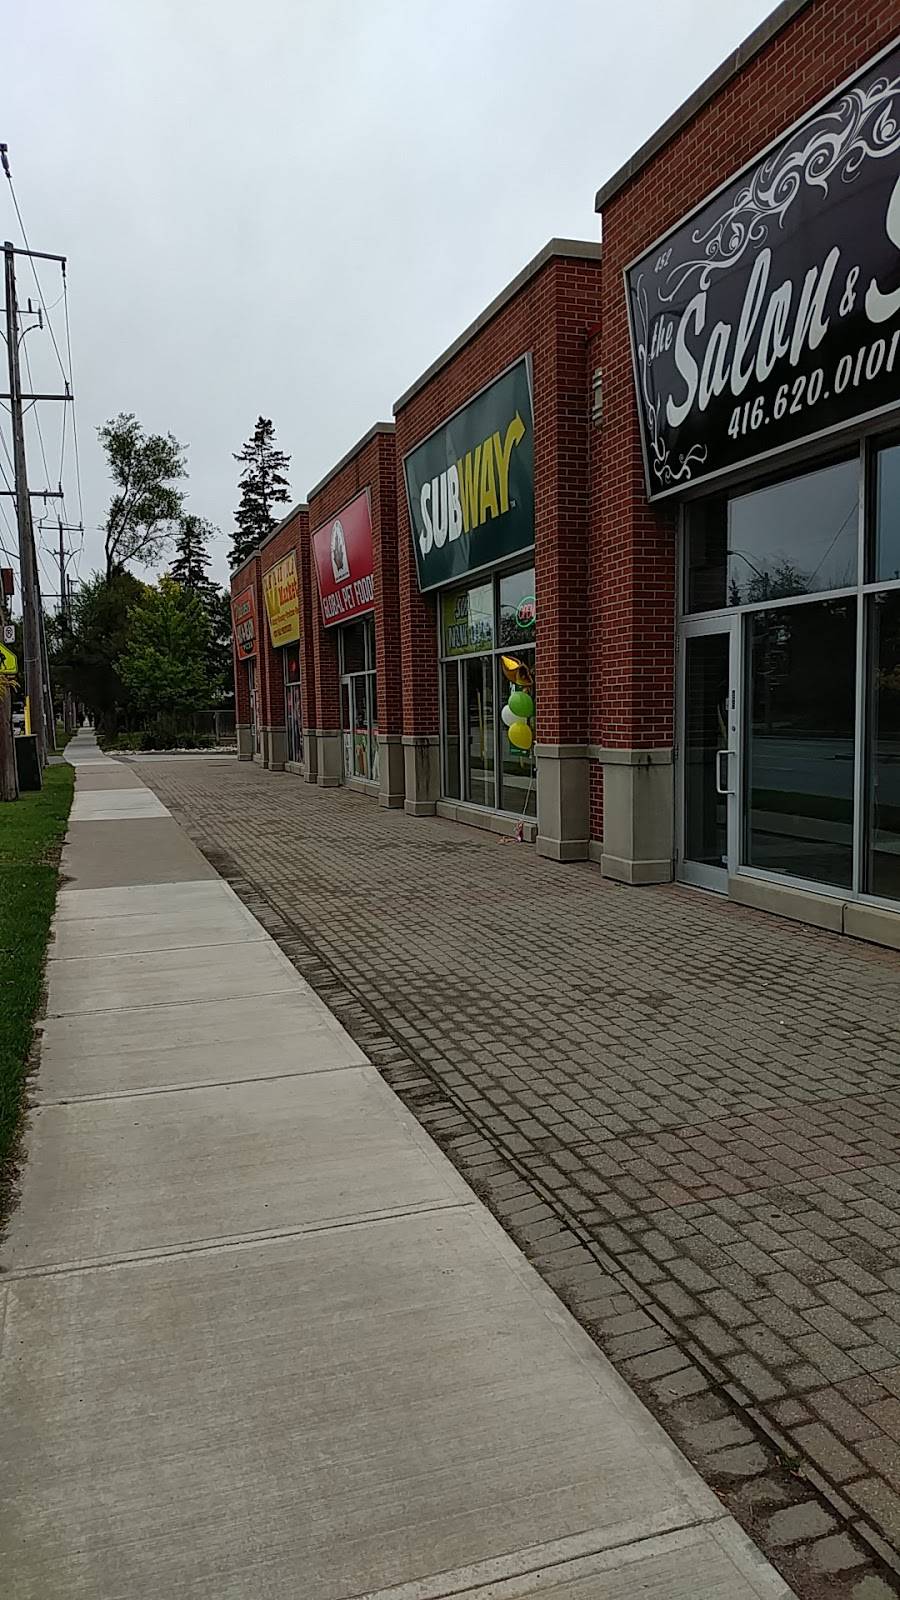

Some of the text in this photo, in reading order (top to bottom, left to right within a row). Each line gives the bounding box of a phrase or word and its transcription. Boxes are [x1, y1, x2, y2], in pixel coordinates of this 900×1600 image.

[648, 246, 861, 429] the Salon &
[727, 329, 900, 440] 416.620.0101
[418, 410, 526, 561] SUBWAY
[322, 590, 346, 619] GLOBAL
[341, 584, 356, 611] PET
